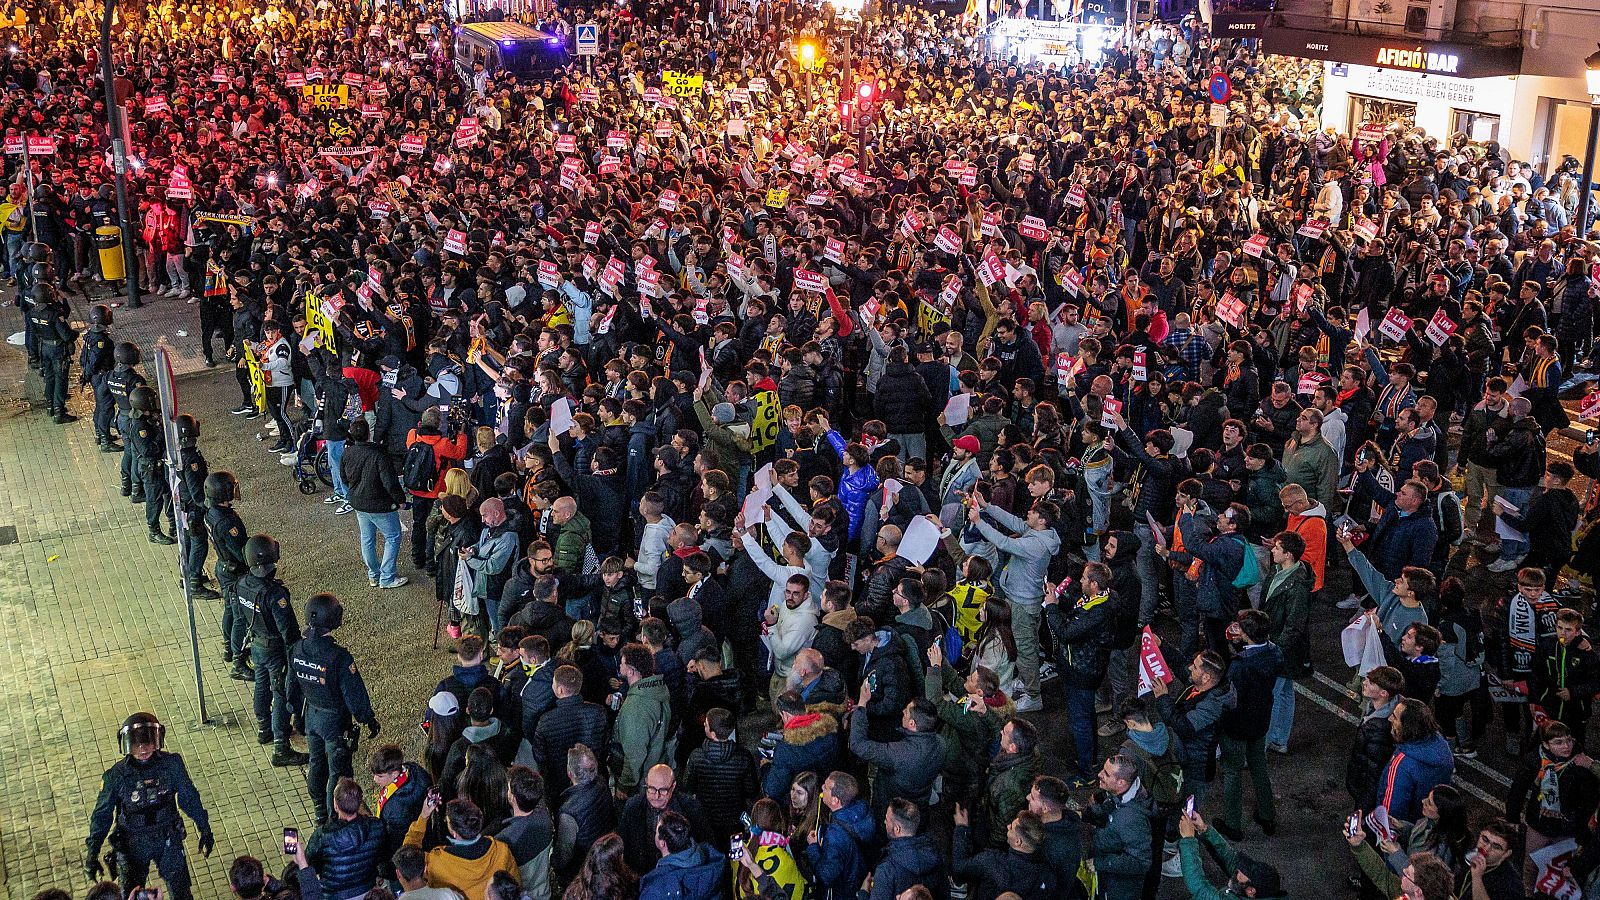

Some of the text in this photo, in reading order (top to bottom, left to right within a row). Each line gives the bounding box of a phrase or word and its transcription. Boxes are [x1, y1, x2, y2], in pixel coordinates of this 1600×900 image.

[1306, 43, 1329, 51] MORITZ
[1427, 52, 1459, 73] BAR
[312, 84, 339, 95] LIM
[1428, 80, 1447, 90] BUEN
[1448, 83, 1475, 93] COMER
[1415, 88, 1424, 96] AL
[1426, 89, 1446, 99] BUEN
[1447, 92, 1474, 103] BEBER
[1072, 186, 1083, 195] LIM
[908, 214, 918, 227] LIM
[983, 214, 994, 222] LIM
[832, 242, 841, 250] LIM
[950, 235, 960, 244] LIM
[943, 243, 959, 253] HOME
[545, 264, 556, 272] LIM
[992, 262, 1002, 277] LIM
[647, 273, 656, 281] LIM
[924, 306, 943, 321] LIM
[314, 314, 324, 328] GO
[1392, 314, 1407, 327] LIM
[1438, 316, 1452, 331] LIM
[1382, 323, 1401, 338] HOME
[1427, 325, 1444, 342] HOME
[1145, 652, 1165, 679] LIM
